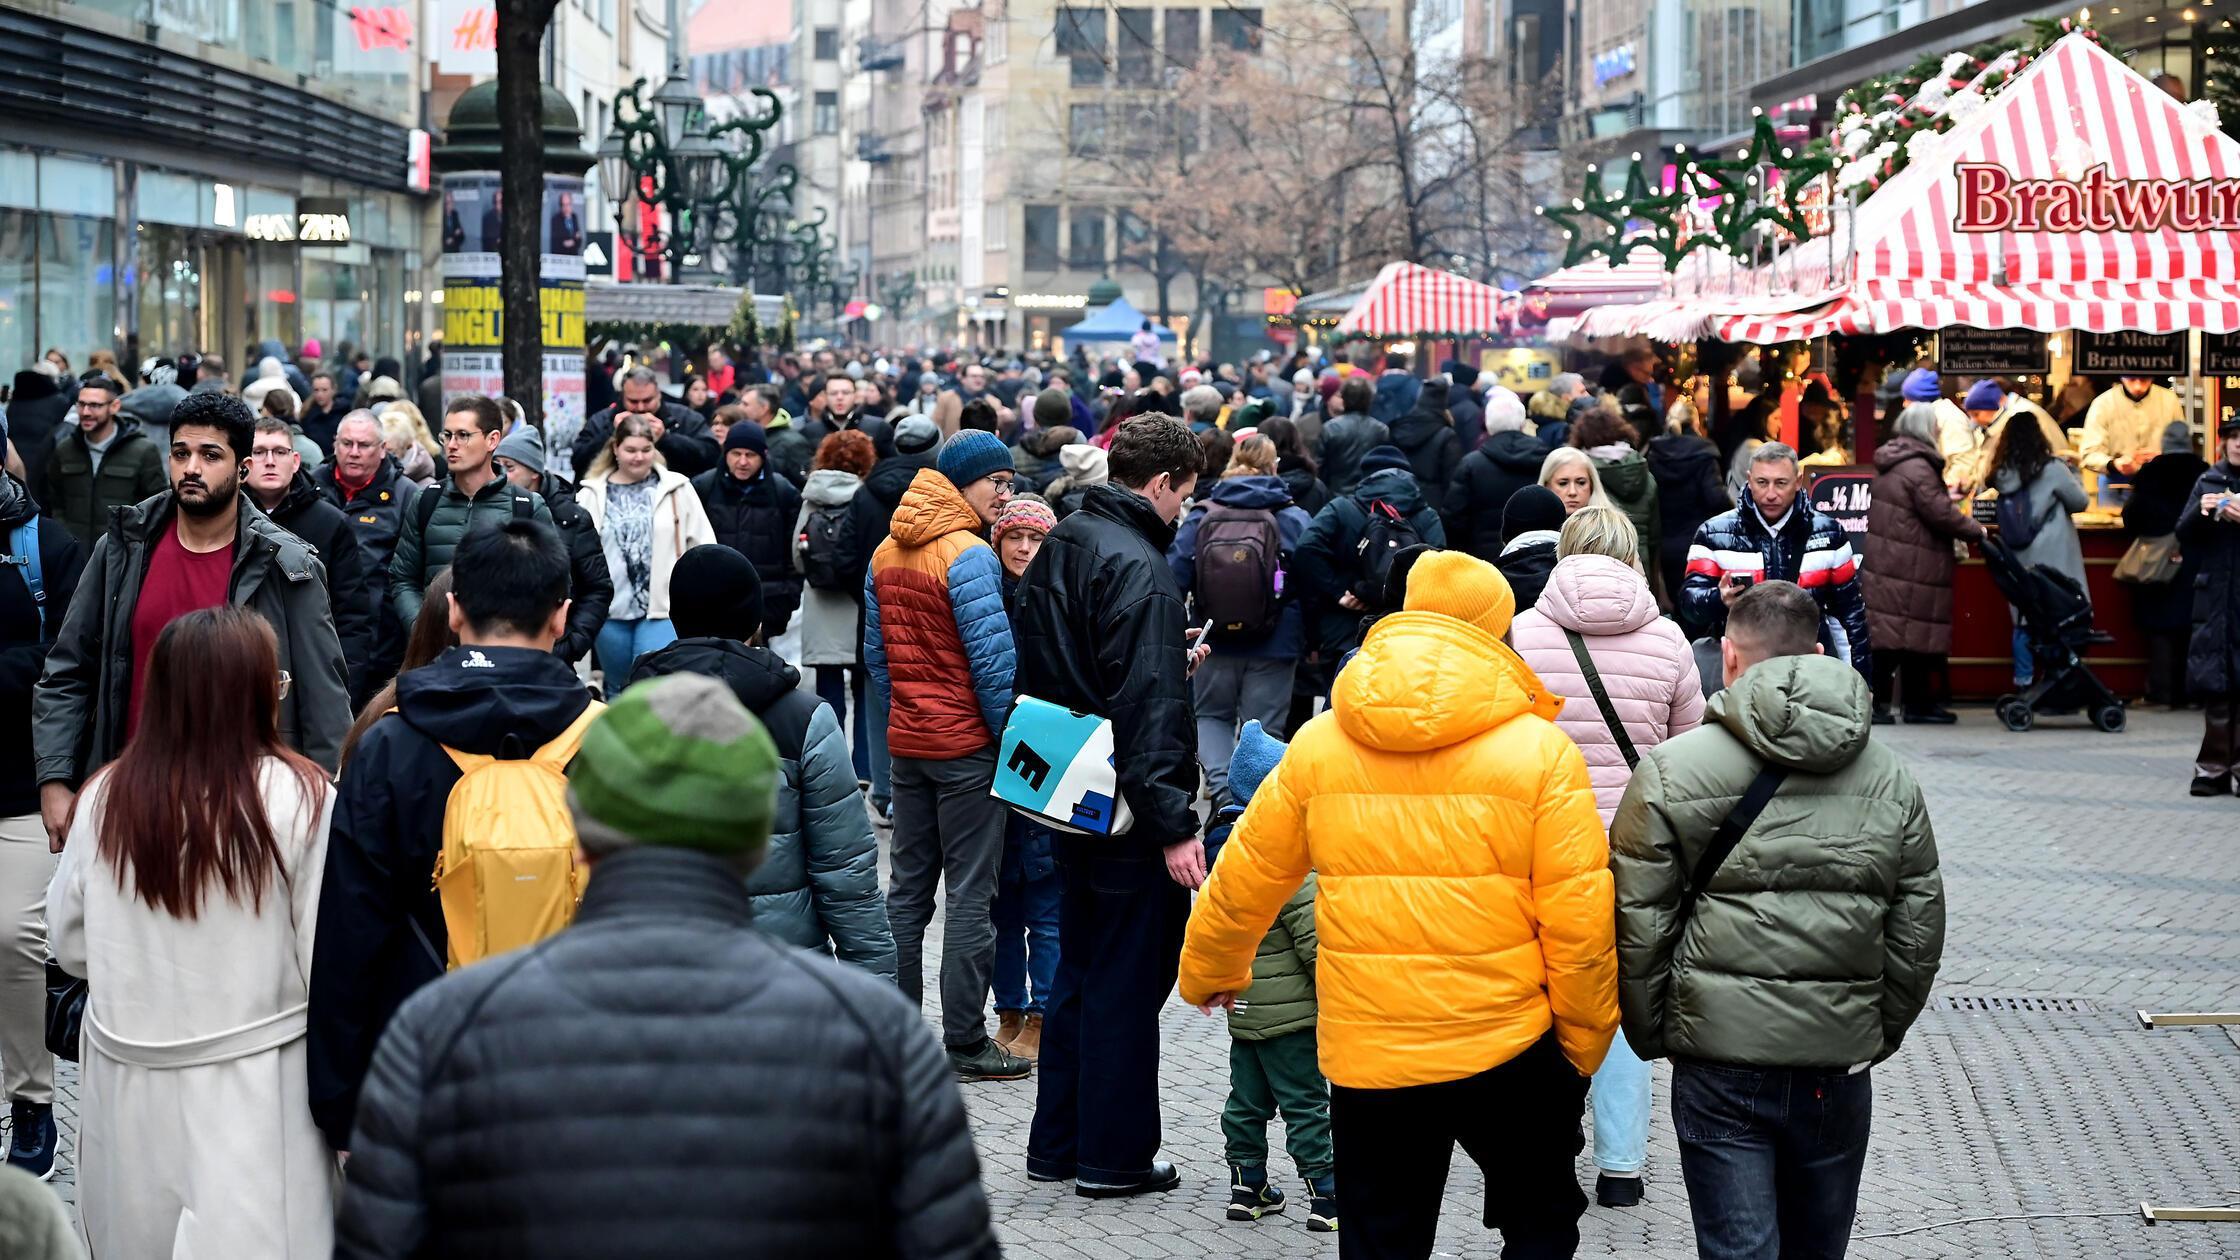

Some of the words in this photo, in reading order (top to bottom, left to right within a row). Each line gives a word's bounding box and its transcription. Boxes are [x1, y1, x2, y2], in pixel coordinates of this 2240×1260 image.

[2121, 331, 2170, 347] Meter
[2087, 351, 2174, 368] Bratwurst
[461, 659, 496, 668] CAMEL
